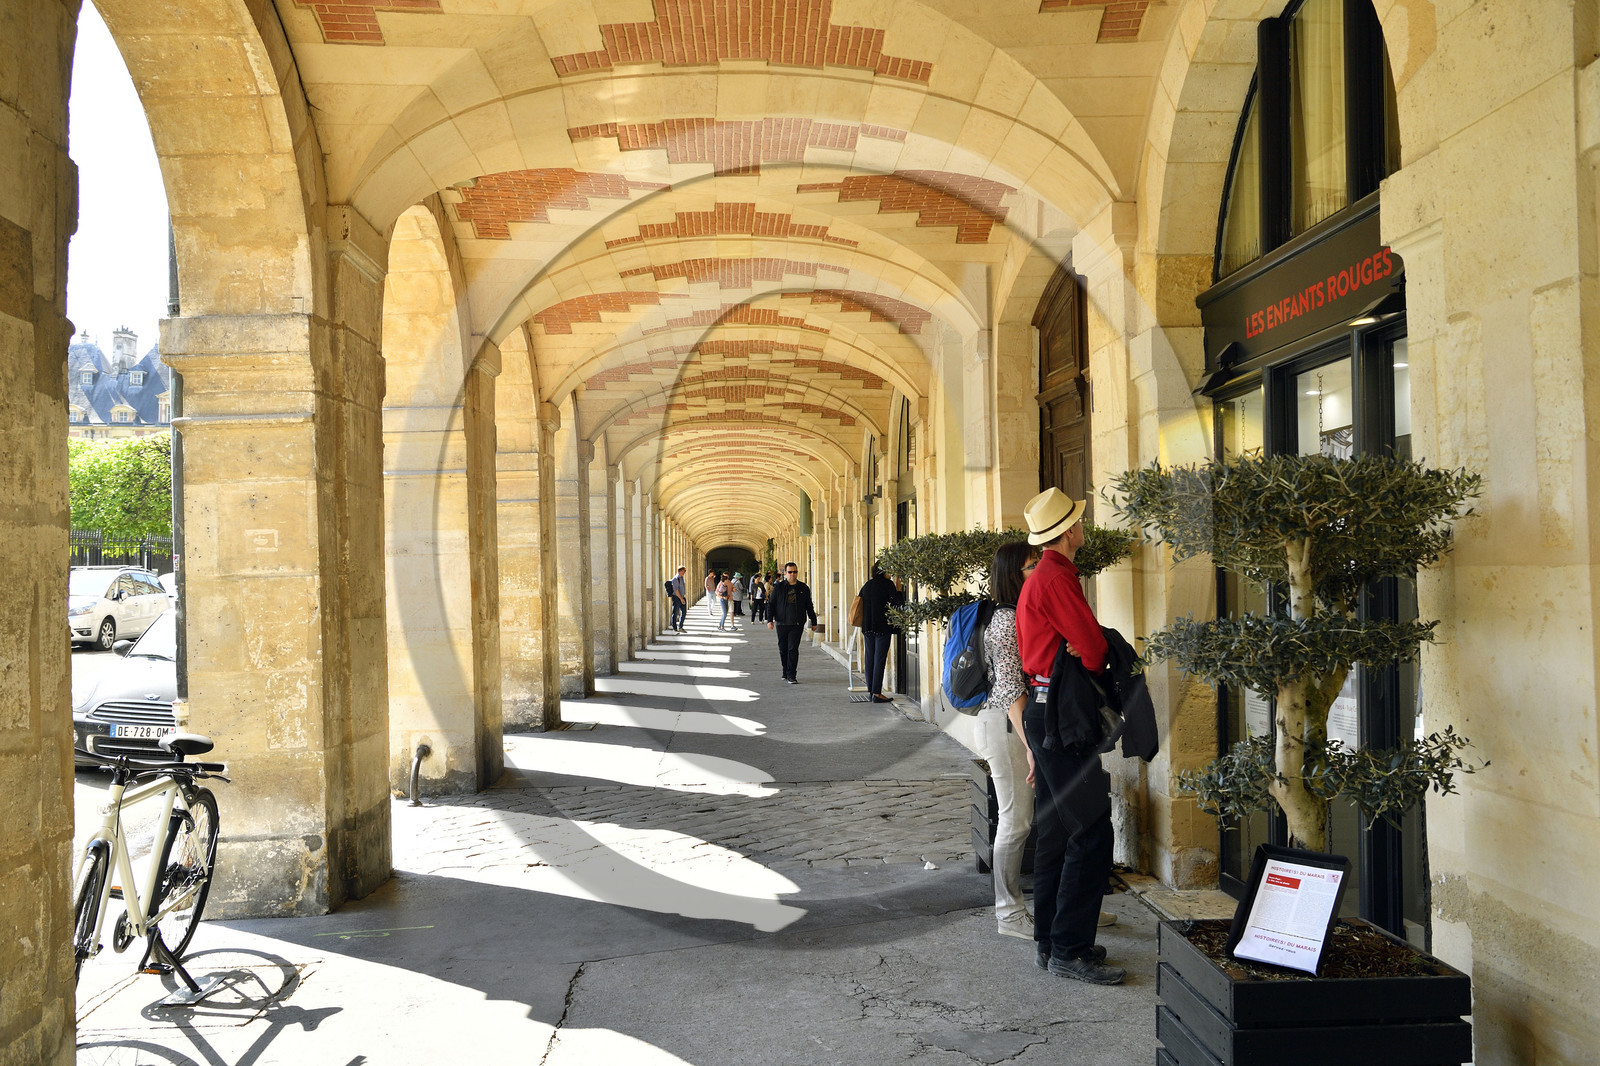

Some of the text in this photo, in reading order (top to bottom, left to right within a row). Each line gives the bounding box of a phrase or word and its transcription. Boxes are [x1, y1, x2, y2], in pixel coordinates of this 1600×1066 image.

[1246, 247, 1393, 340] LES ENFANTS ROUGES
[1271, 866, 1298, 875] HISTOIRE(S)
[1254, 934, 1286, 945] HISTOIRE(S)
[1295, 944, 1317, 953] MARAIS
